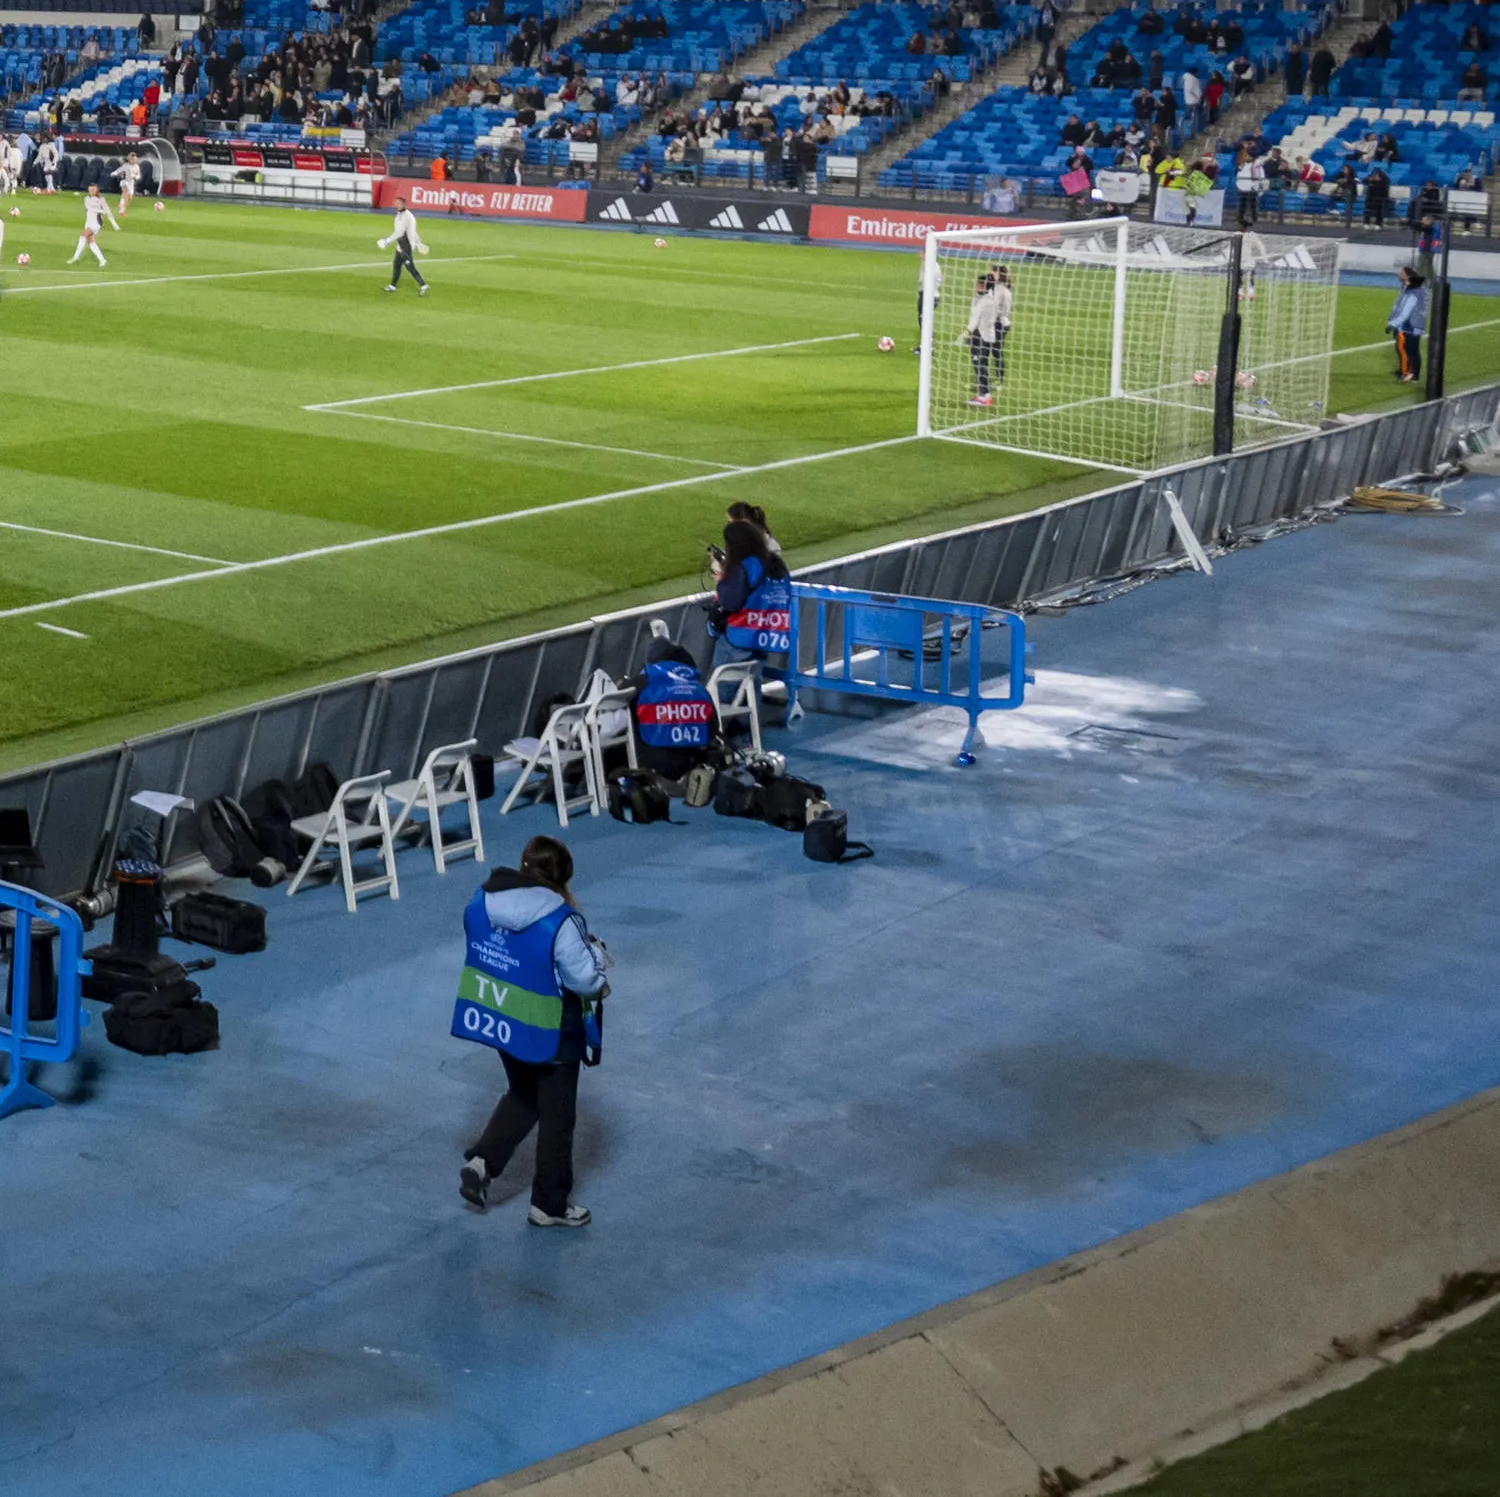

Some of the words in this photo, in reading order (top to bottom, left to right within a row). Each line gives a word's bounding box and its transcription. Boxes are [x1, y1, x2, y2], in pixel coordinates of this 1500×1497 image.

[490, 191, 512, 209] FLY
[511, 193, 553, 213] BETTER
[758, 632, 790, 649] 076
[671, 726, 700, 742] 042
[471, 941, 520, 967] CHAMPIONS
[479, 953, 510, 971] LEAGUE
[475, 974, 509, 1007] TV
[463, 1006, 511, 1044] 020
